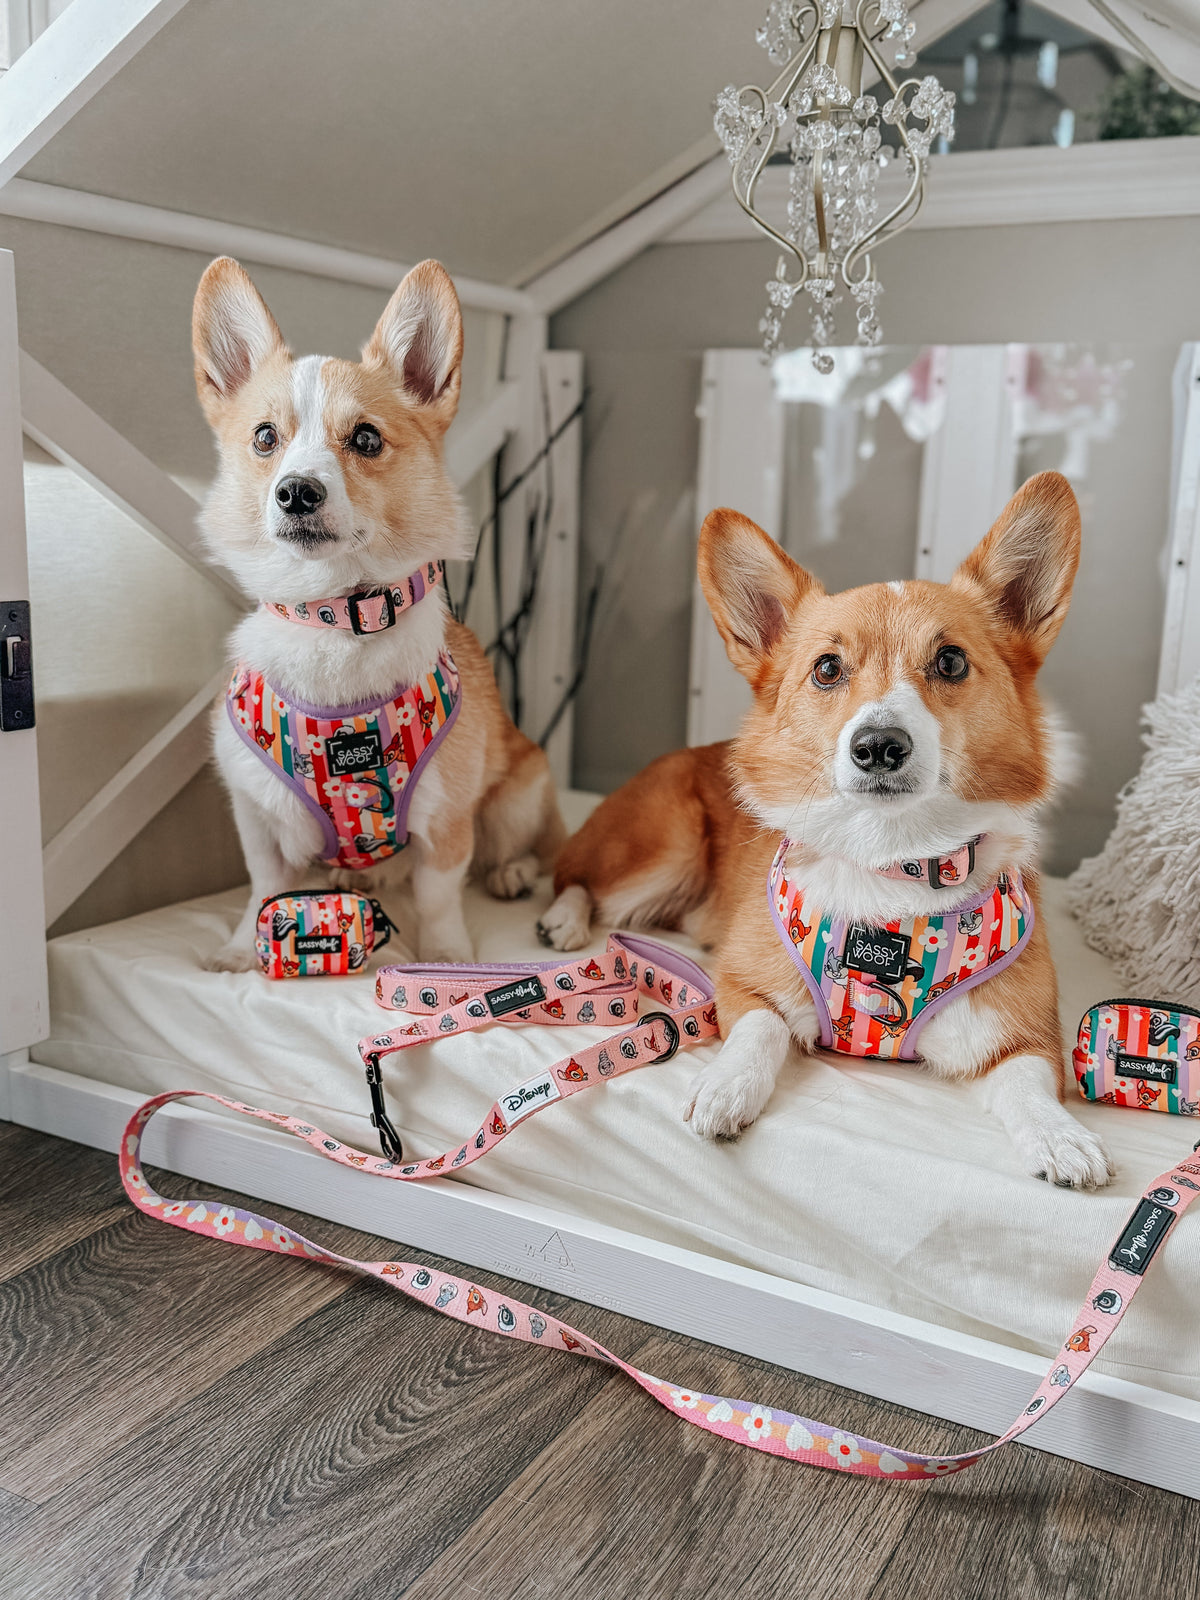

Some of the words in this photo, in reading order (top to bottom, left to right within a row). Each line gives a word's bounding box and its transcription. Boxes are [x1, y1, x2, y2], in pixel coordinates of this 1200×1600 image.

[337, 744, 374, 760] SASSY
[335, 753, 374, 767] WOOF
[297, 941, 319, 949] SASSY
[855, 940, 899, 960] SASSY
[852, 947, 895, 967] WOOF
[490, 990, 515, 1005] SASSY
[1119, 1060, 1146, 1071] SASSY
[1141, 1207, 1163, 1237] SASSY
